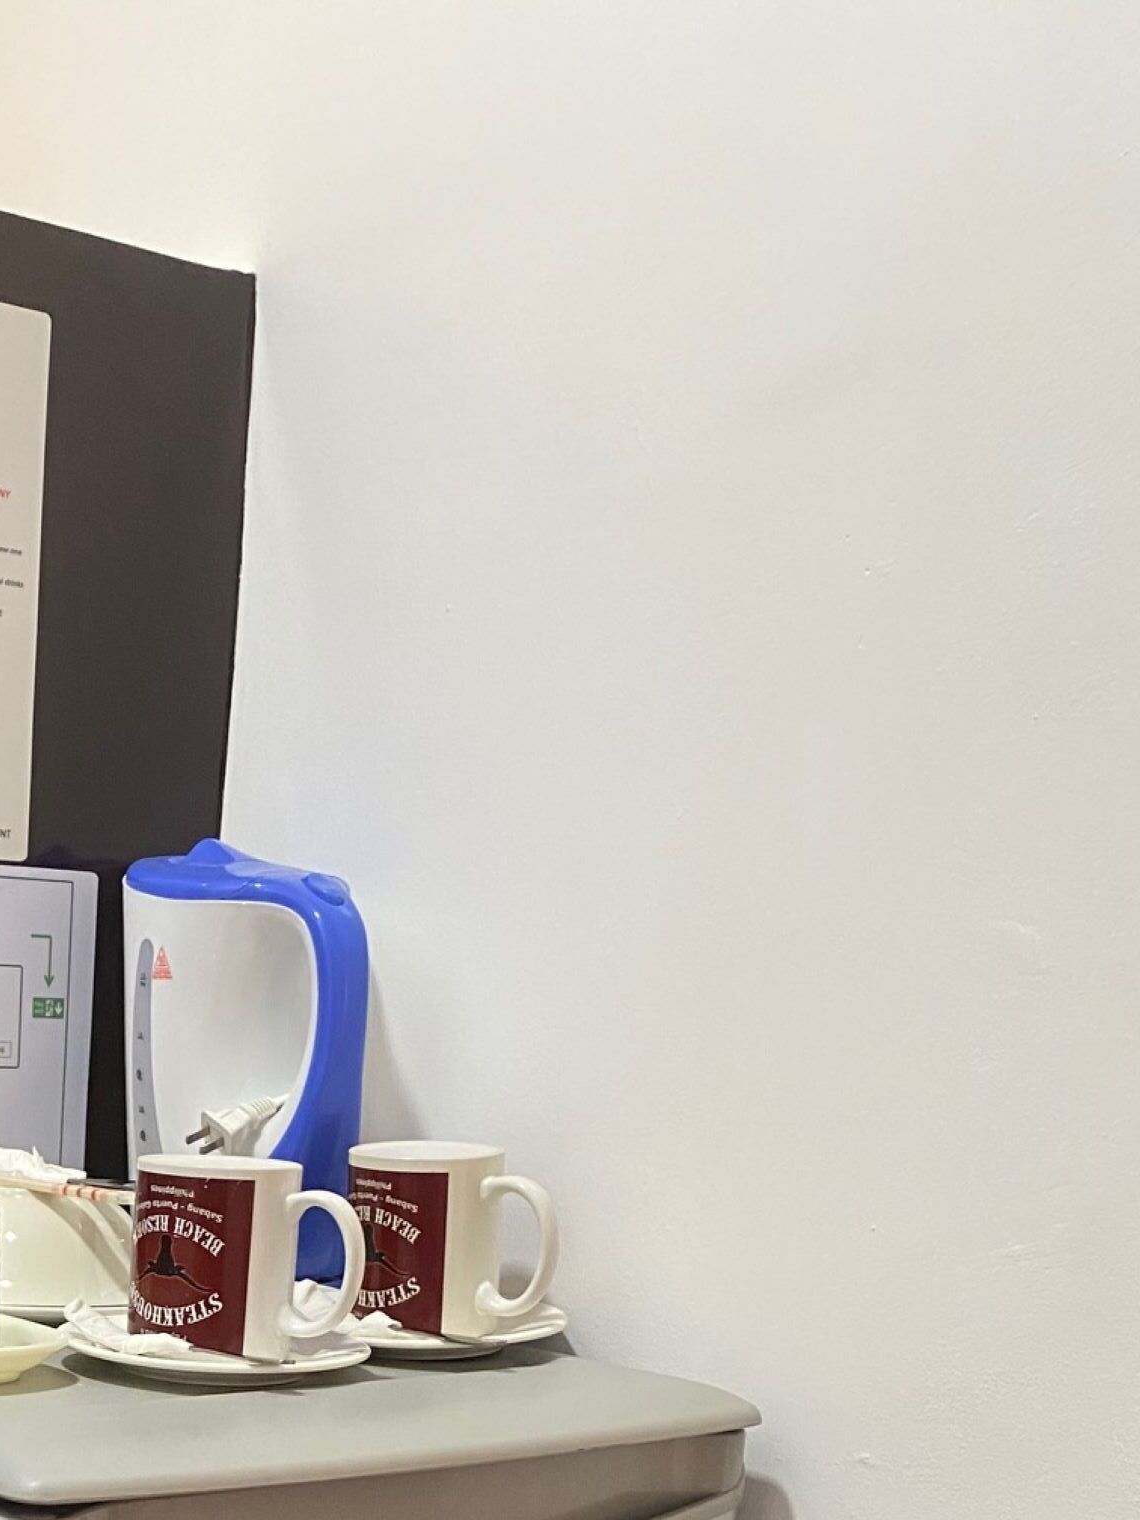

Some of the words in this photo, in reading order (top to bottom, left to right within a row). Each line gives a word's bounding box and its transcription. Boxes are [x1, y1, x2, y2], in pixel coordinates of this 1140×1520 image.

[187, 1203, 224, 1223] Sabang
[384, 1195, 419, 1213] Sabang
[173, 1216, 225, 1257] BEACH
[374, 1207, 422, 1245] BEACH
